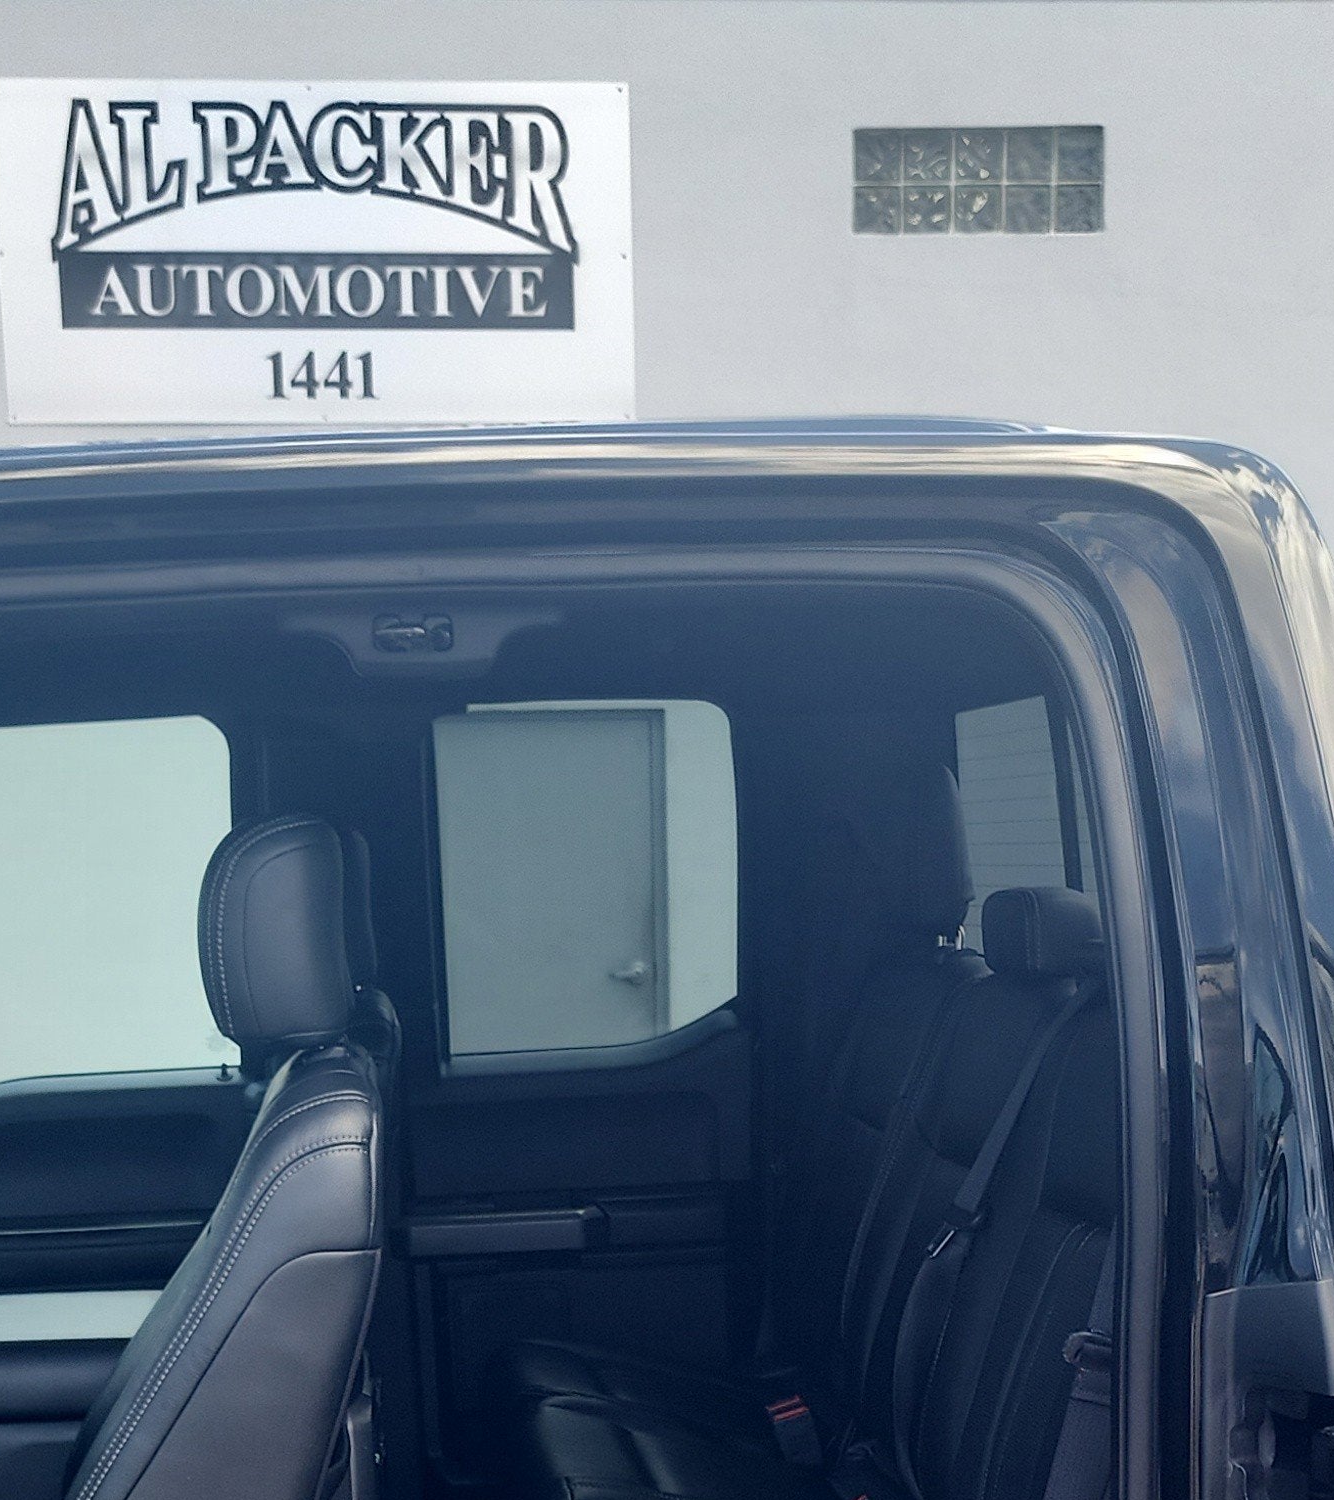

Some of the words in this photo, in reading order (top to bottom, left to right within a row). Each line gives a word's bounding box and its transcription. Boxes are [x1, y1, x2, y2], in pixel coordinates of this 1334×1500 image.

[53, 98, 188, 260] AL
[192, 101, 578, 260] PACKER
[90, 264, 547, 318] AUTOMOTIVE
[267, 350, 379, 399] 1441
